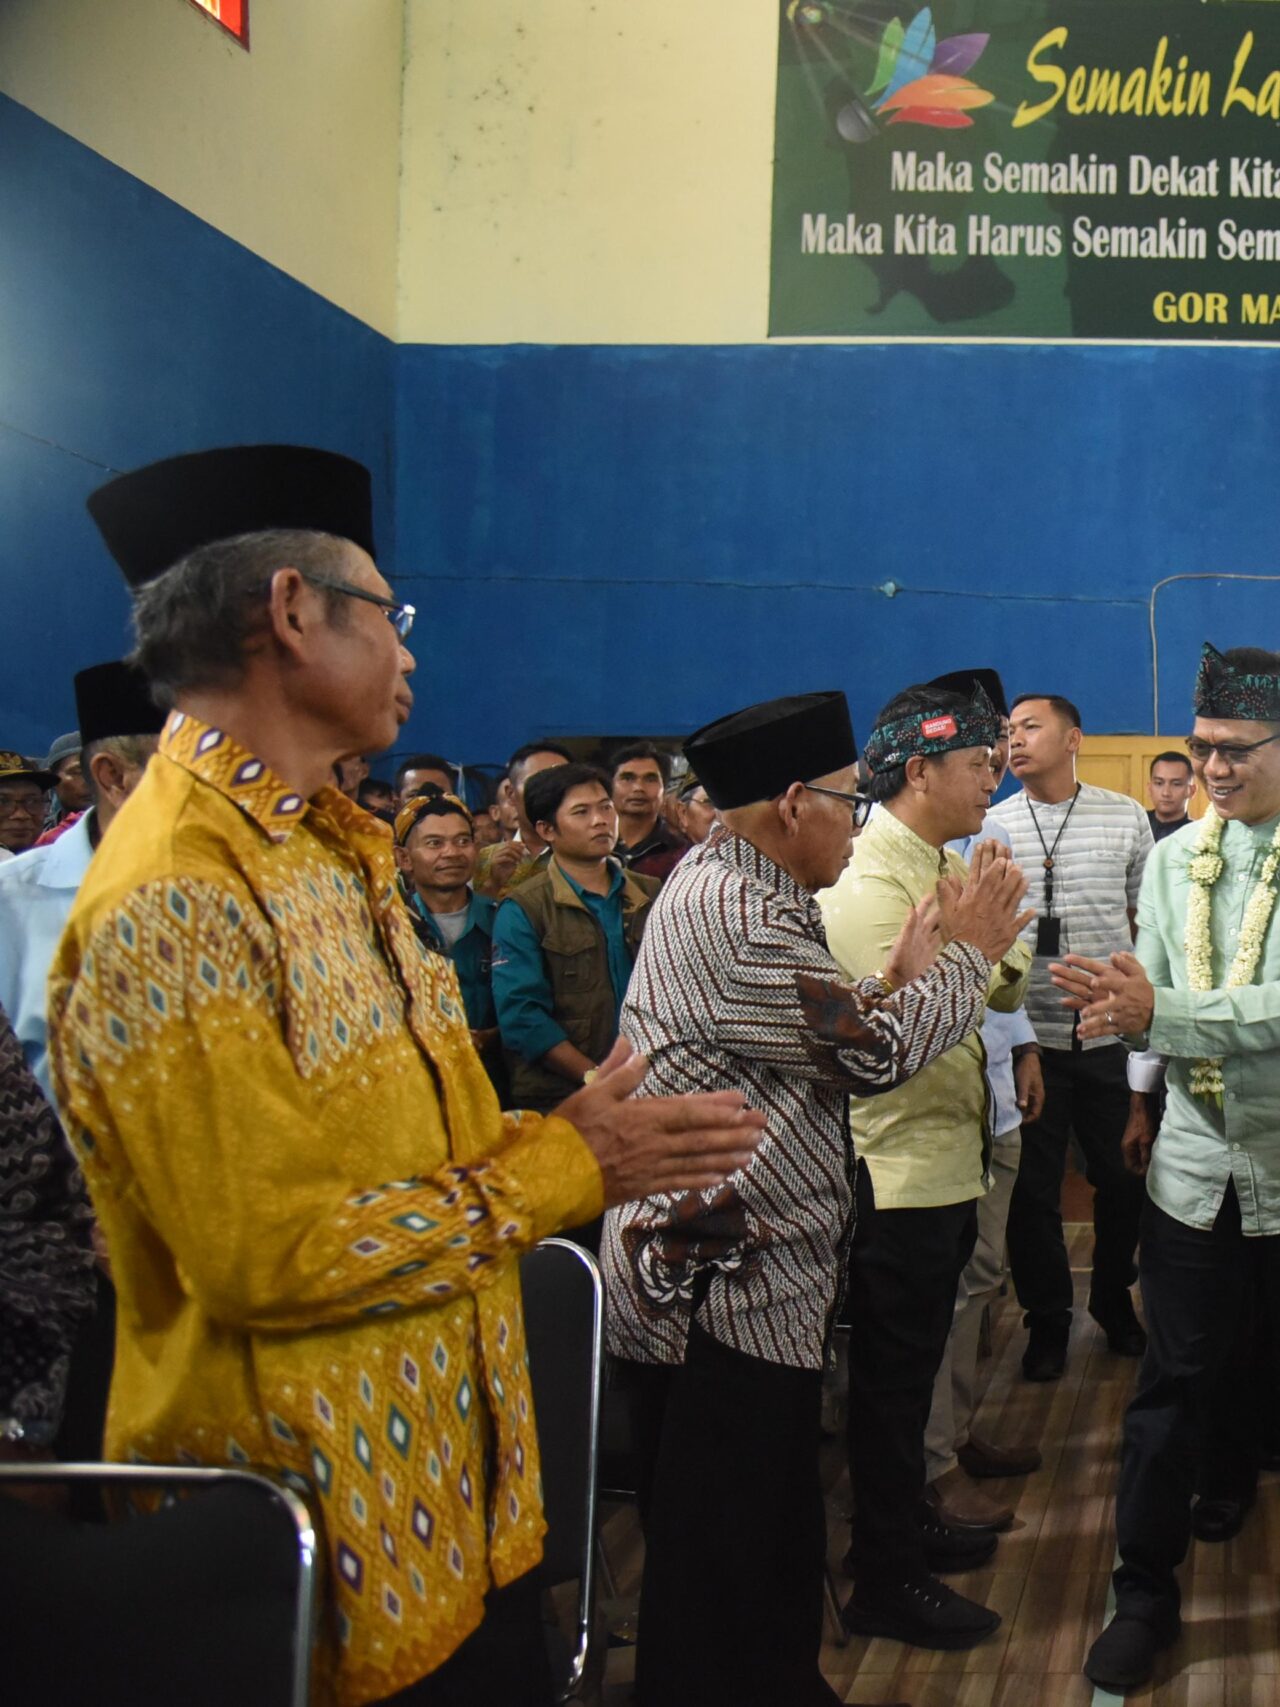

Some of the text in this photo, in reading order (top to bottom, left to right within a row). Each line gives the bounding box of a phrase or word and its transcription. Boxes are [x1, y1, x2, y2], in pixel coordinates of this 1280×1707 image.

[1012, 26, 1210, 129] Semakin
[891, 151, 974, 193] Maka
[983, 152, 1118, 195] Semakin
[1129, 154, 1219, 197] Dekat
[801, 213, 885, 255] Maka
[893, 213, 958, 256] Kita
[966, 214, 1062, 257] Harus
[1072, 216, 1207, 259] Semakin
[1152, 291, 1228, 324] GOR
